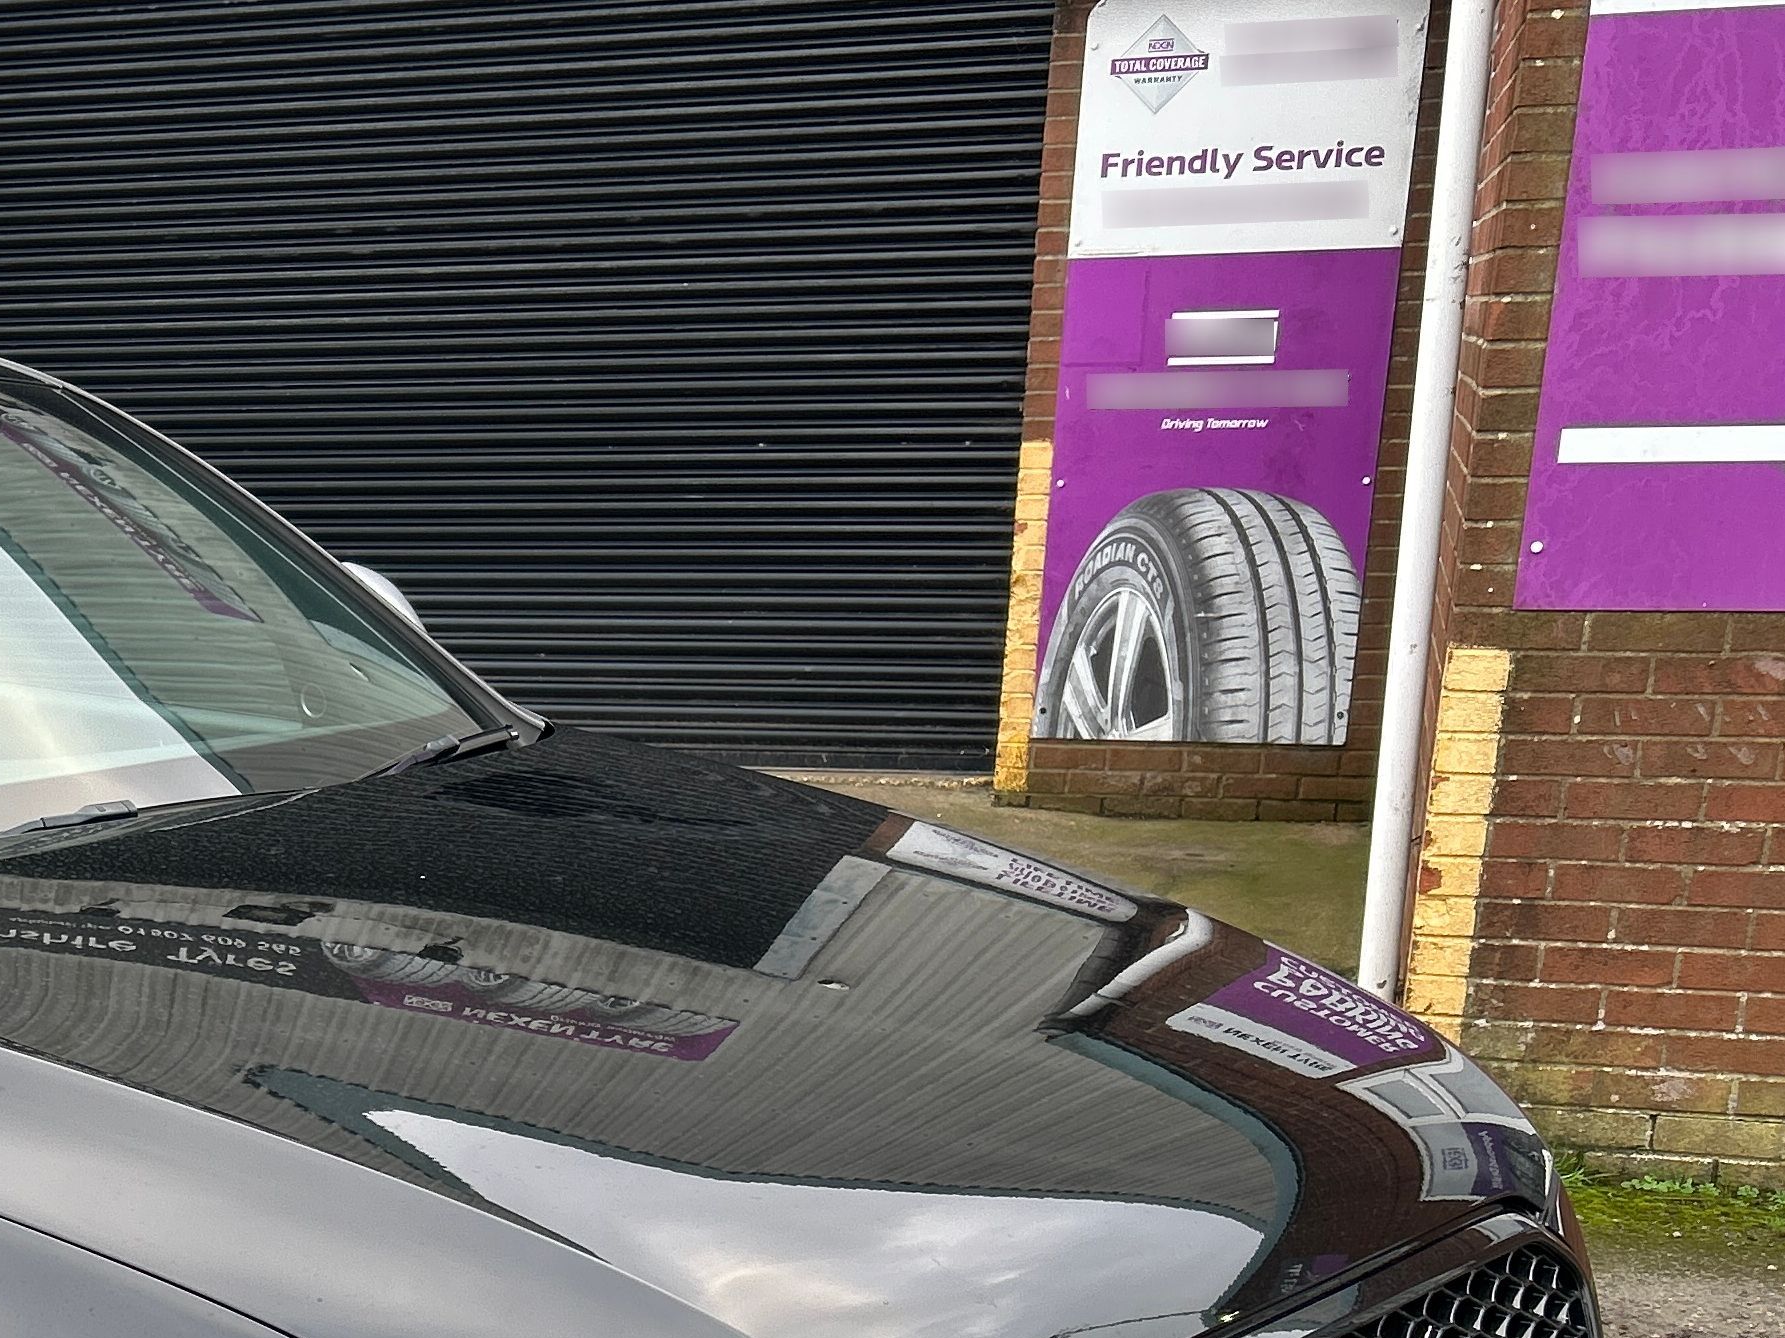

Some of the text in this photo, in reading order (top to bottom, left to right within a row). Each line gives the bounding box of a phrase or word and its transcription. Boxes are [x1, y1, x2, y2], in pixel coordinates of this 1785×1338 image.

[1114, 55, 1206, 73] TOTAL COVERAGE
[1134, 75, 1183, 84] WARRANTY
[1100, 142, 1386, 179] Friendly Service
[1160, 417, 1270, 432] Driving Tomorrow
[1074, 541, 1136, 601] ROADIAN
